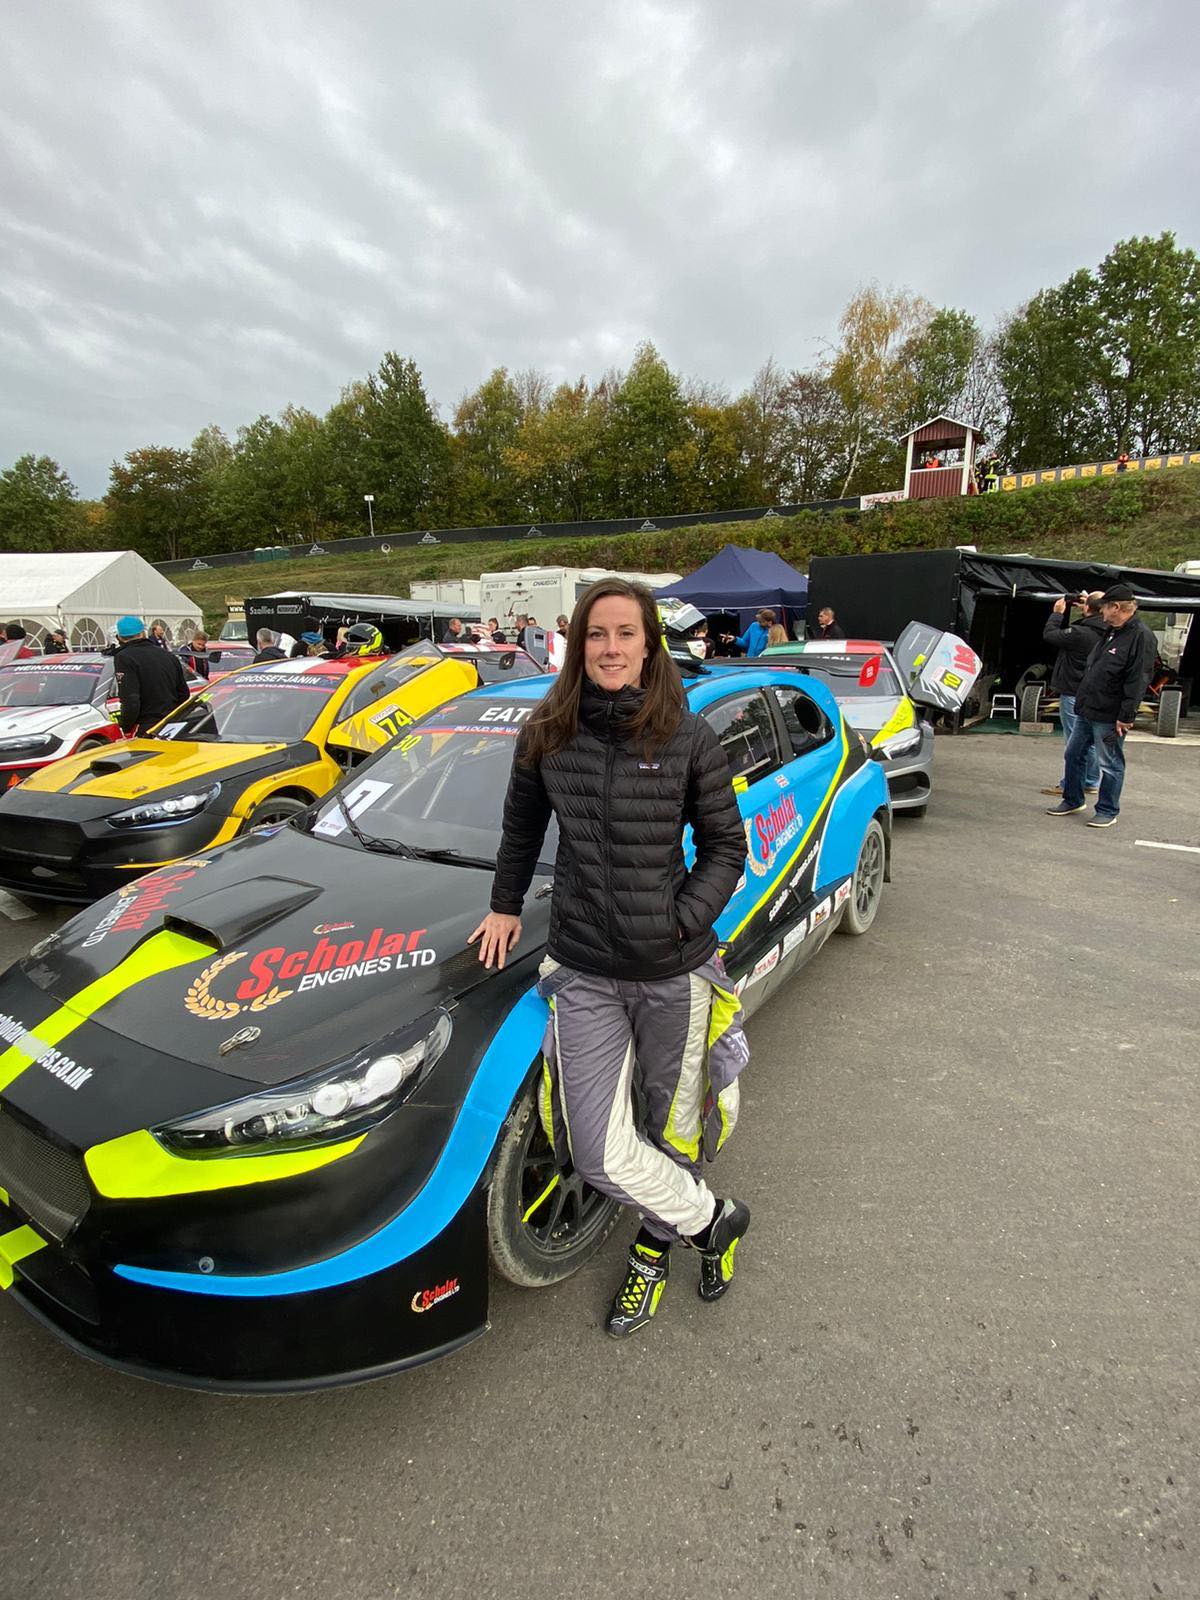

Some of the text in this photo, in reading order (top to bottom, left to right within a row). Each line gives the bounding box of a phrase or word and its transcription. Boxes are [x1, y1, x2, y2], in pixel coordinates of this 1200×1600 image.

[14, 664, 84, 672] HEIKKINEN
[943, 672, 962, 690] 10
[378, 710, 413, 736] 74
[478, 706, 533, 723] EAT
[754, 792, 798, 860] Scholar
[236, 927, 428, 1000] Scholar
[297, 948, 436, 993] ENGINES LTD
[422, 1277, 458, 1309] Scholar
